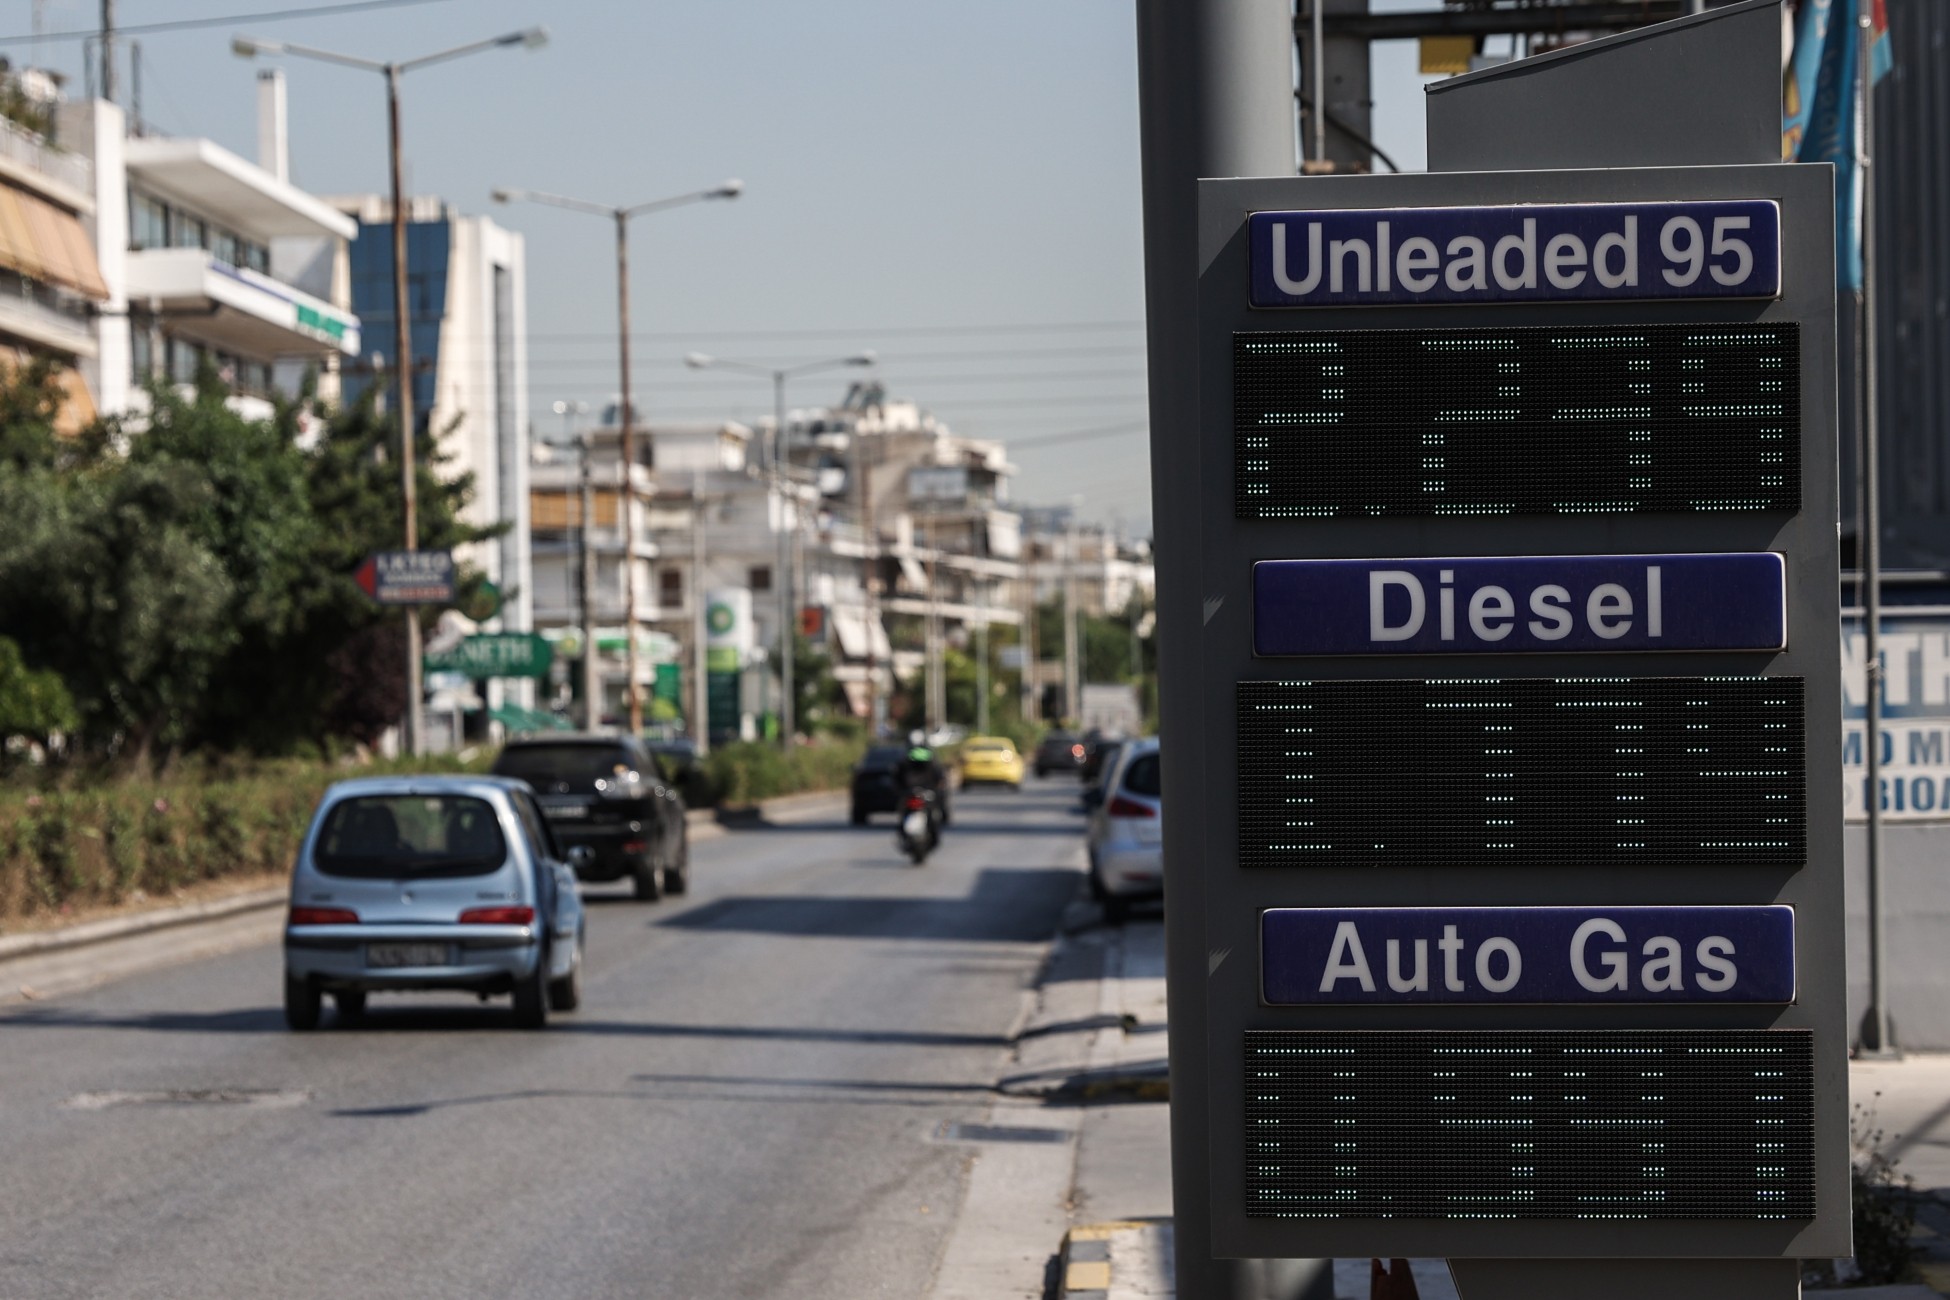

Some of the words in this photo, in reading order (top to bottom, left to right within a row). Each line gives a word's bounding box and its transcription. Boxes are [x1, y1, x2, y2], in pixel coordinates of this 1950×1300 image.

[1271, 214, 1639, 296] Unleaded
[1659, 215, 1754, 288] 95
[1369, 565, 1663, 643] Diesel
[1318, 920, 1523, 993] Auto
[1568, 917, 1739, 993] Gas
